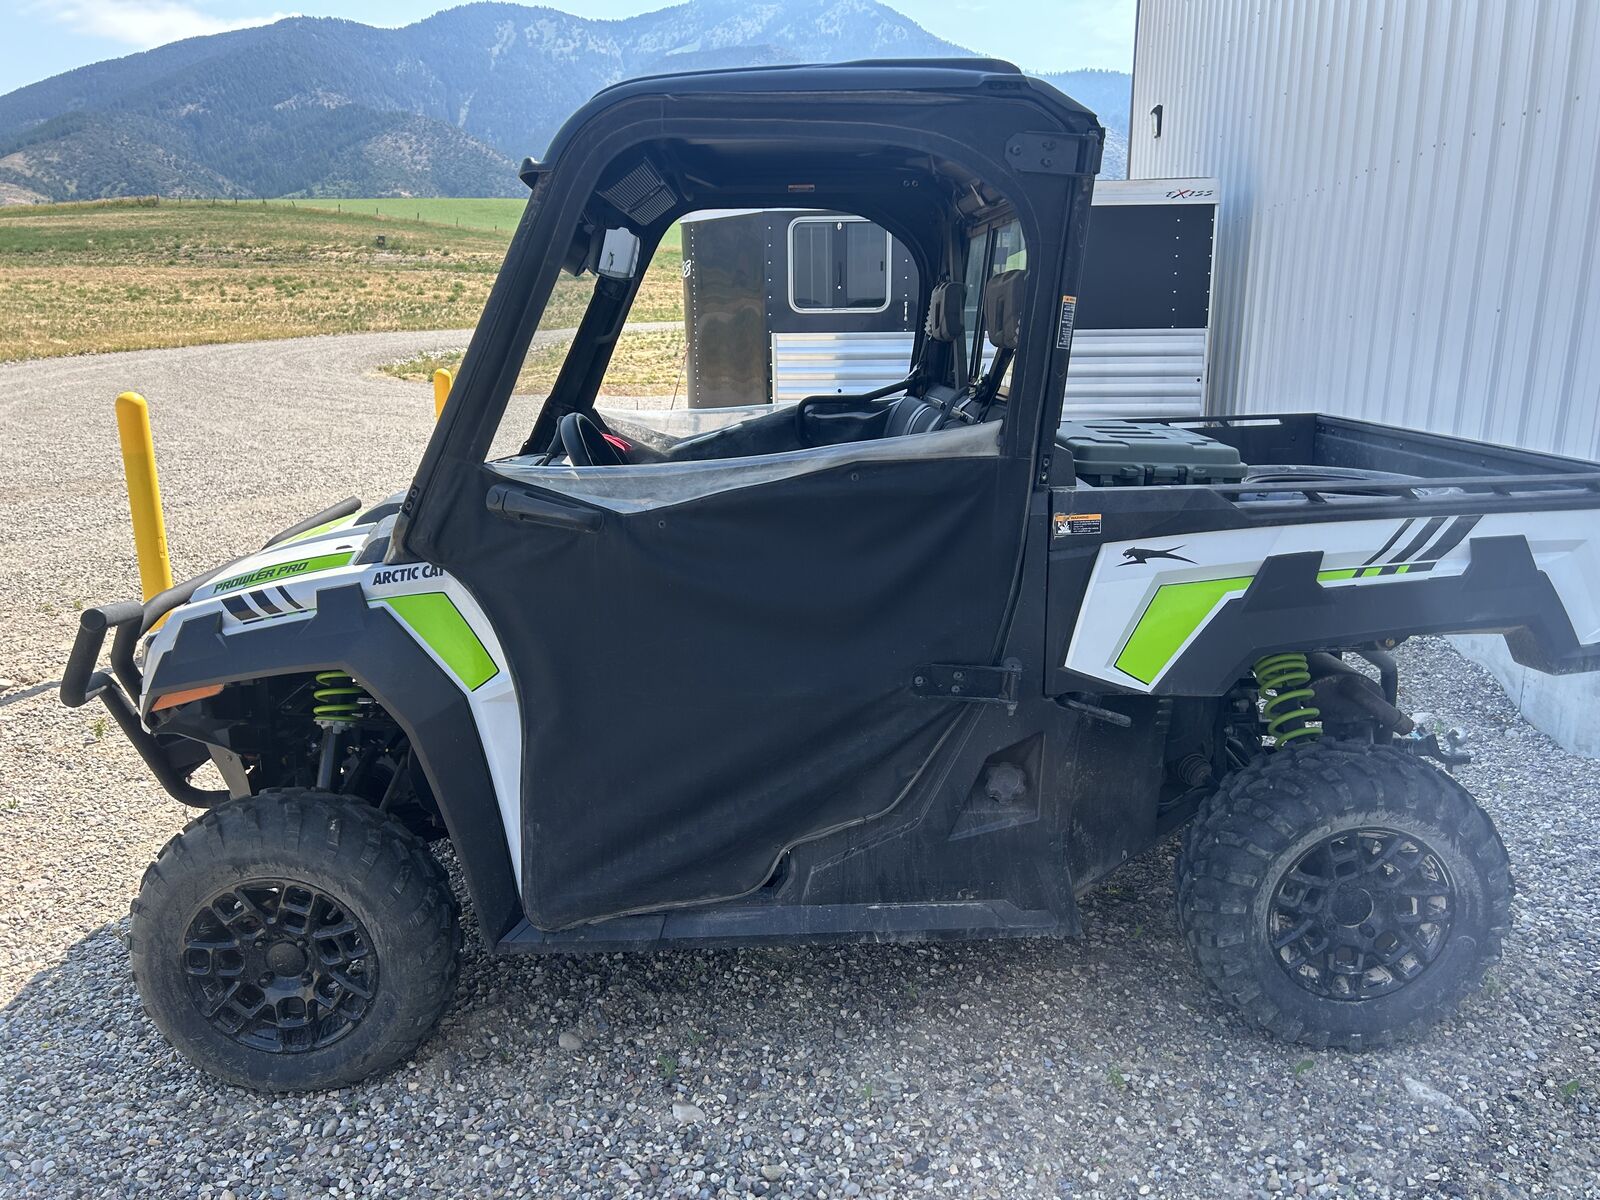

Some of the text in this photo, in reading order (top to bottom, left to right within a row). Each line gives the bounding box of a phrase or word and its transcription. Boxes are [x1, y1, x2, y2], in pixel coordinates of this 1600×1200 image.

[213, 562, 309, 594] PROWLER PRO
[372, 566, 419, 585] ARCTIC
